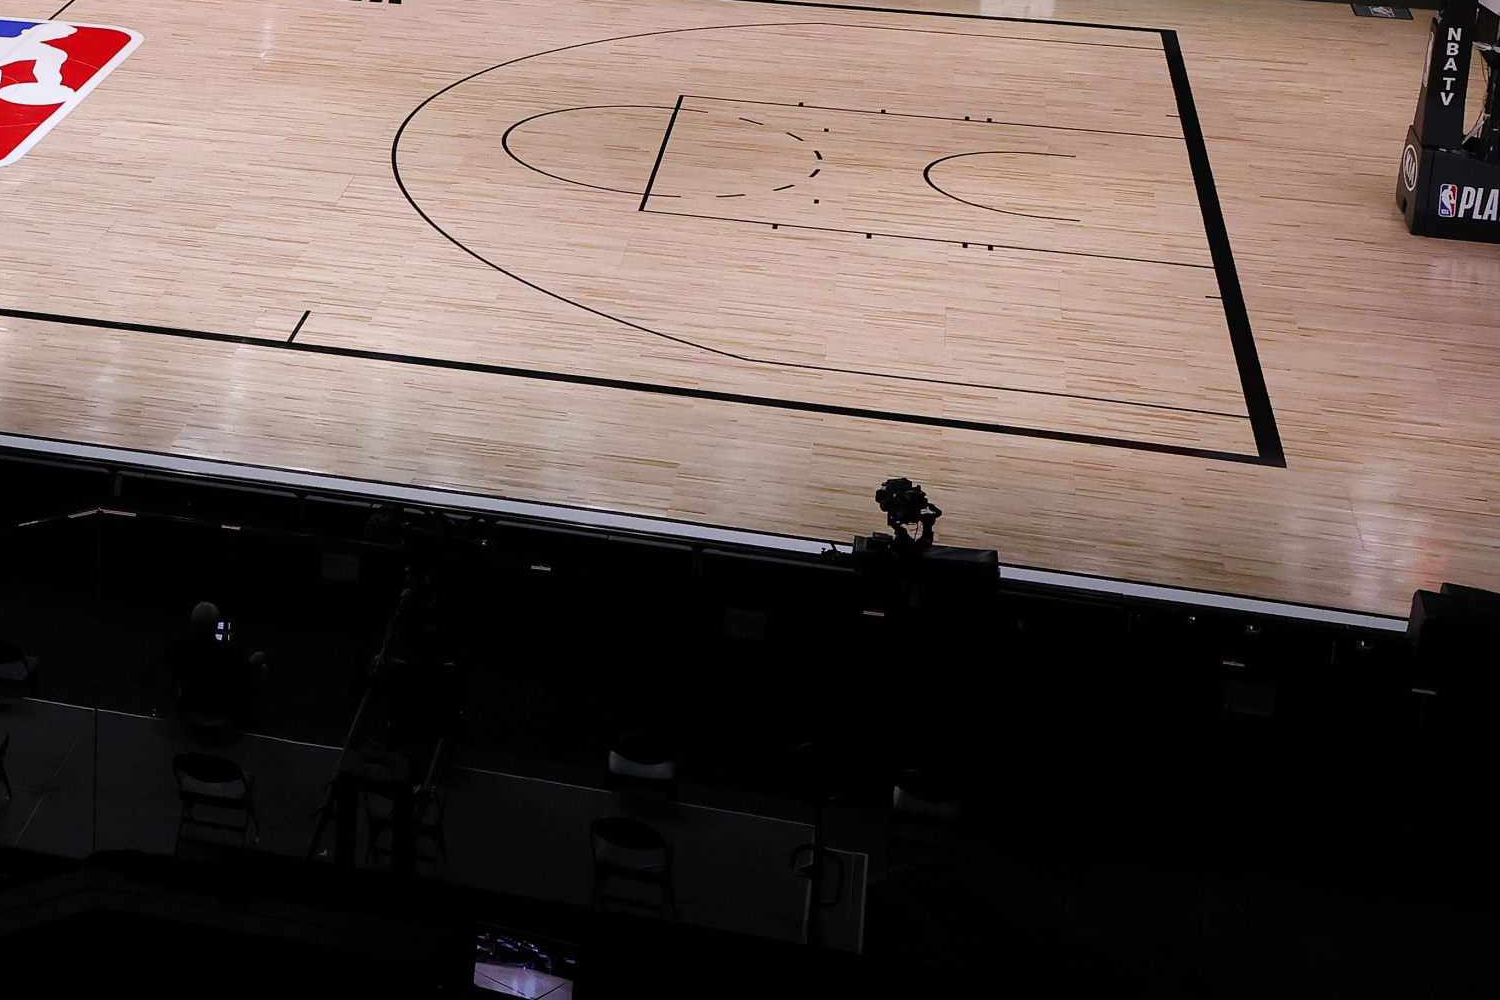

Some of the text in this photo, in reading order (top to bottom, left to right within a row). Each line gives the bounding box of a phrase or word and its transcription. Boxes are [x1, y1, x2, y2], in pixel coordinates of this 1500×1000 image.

[1440, 27, 1462, 106] NBA TV
[1457, 186, 1500, 221] PLA
